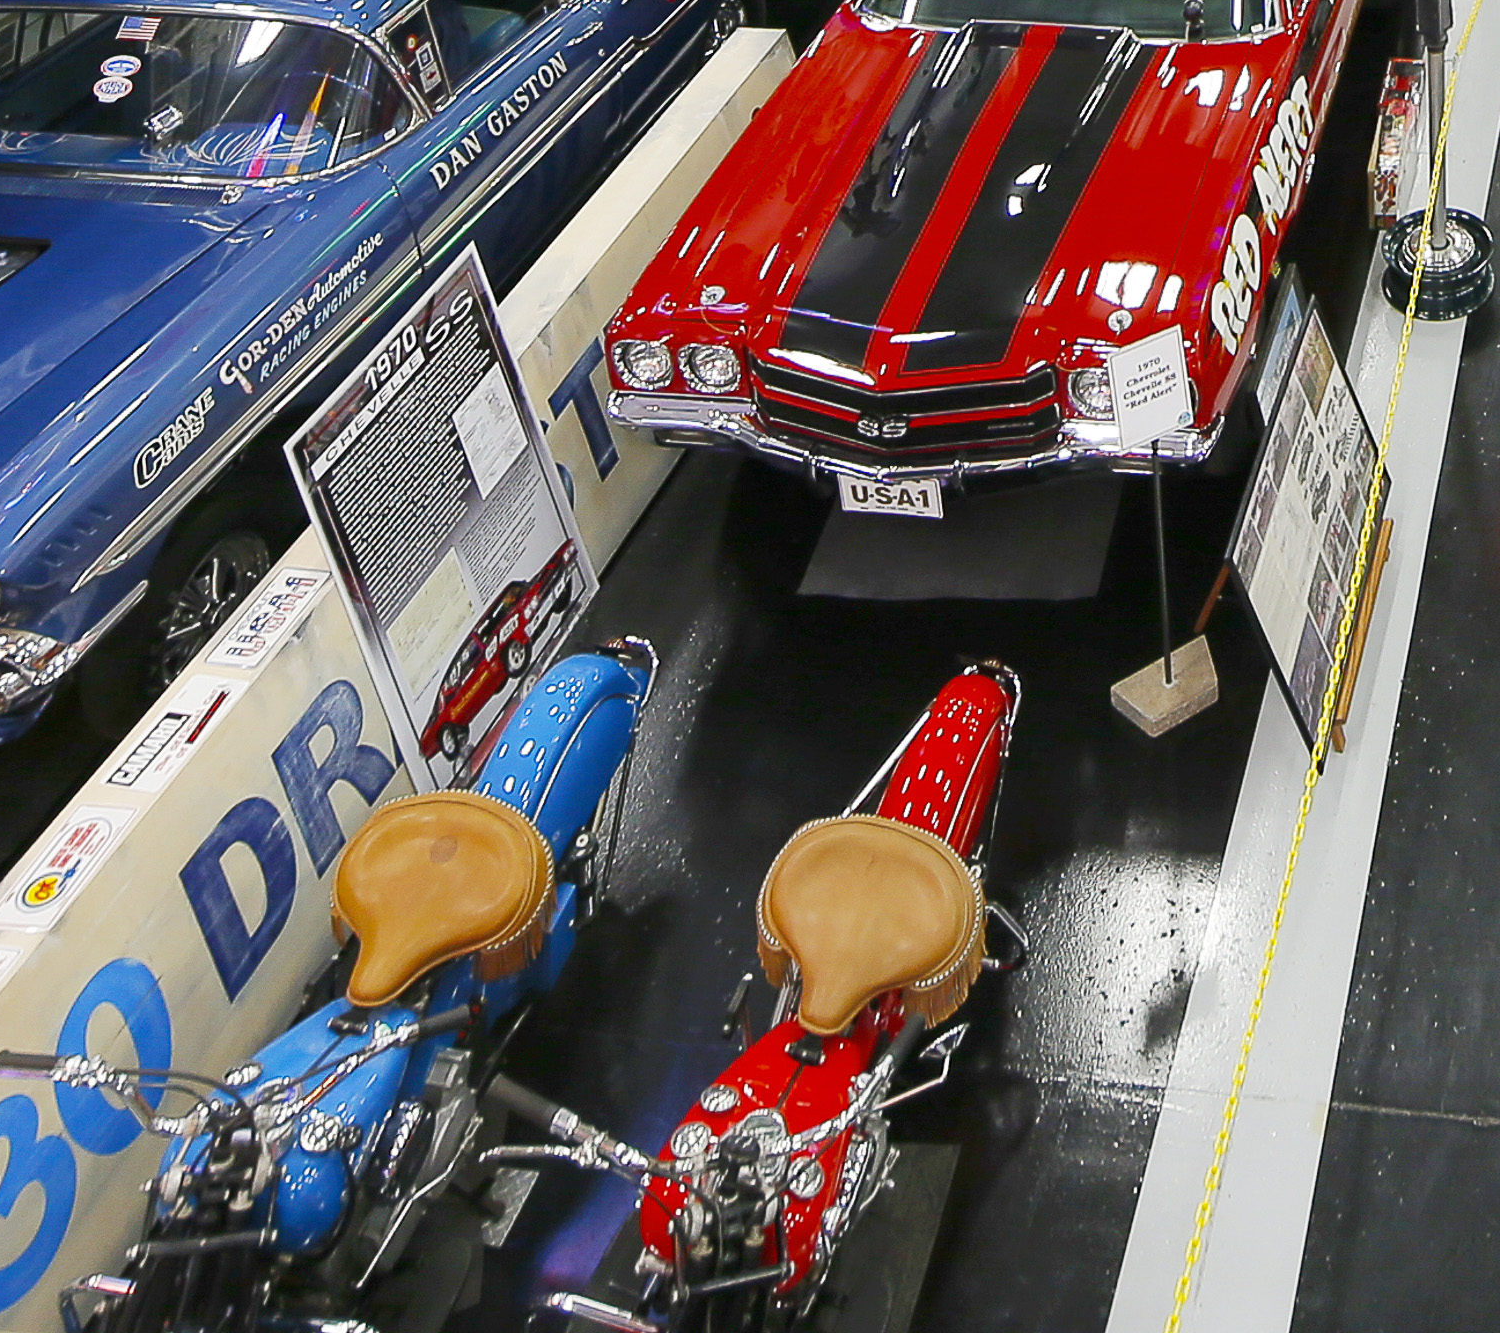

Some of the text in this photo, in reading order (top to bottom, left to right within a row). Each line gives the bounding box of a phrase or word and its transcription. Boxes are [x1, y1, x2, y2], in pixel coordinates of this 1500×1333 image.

[428, 50, 569, 191] DAN GASTON
[1210, 73, 1316, 356] RED ALERT
[306, 231, 384, 311] Automotive
[259, 269, 369, 382] RACING ENGINES
[362, 323, 419, 391] 1970
[323, 287, 476, 464] CHEVELLE SS
[1123, 378, 1162, 400] Chevelle
[1126, 364, 1171, 388] Chevrolet
[1137, 356, 1161, 372] 1970
[857, 415, 909, 439] SS
[117, 714, 186, 785] CAMARO
